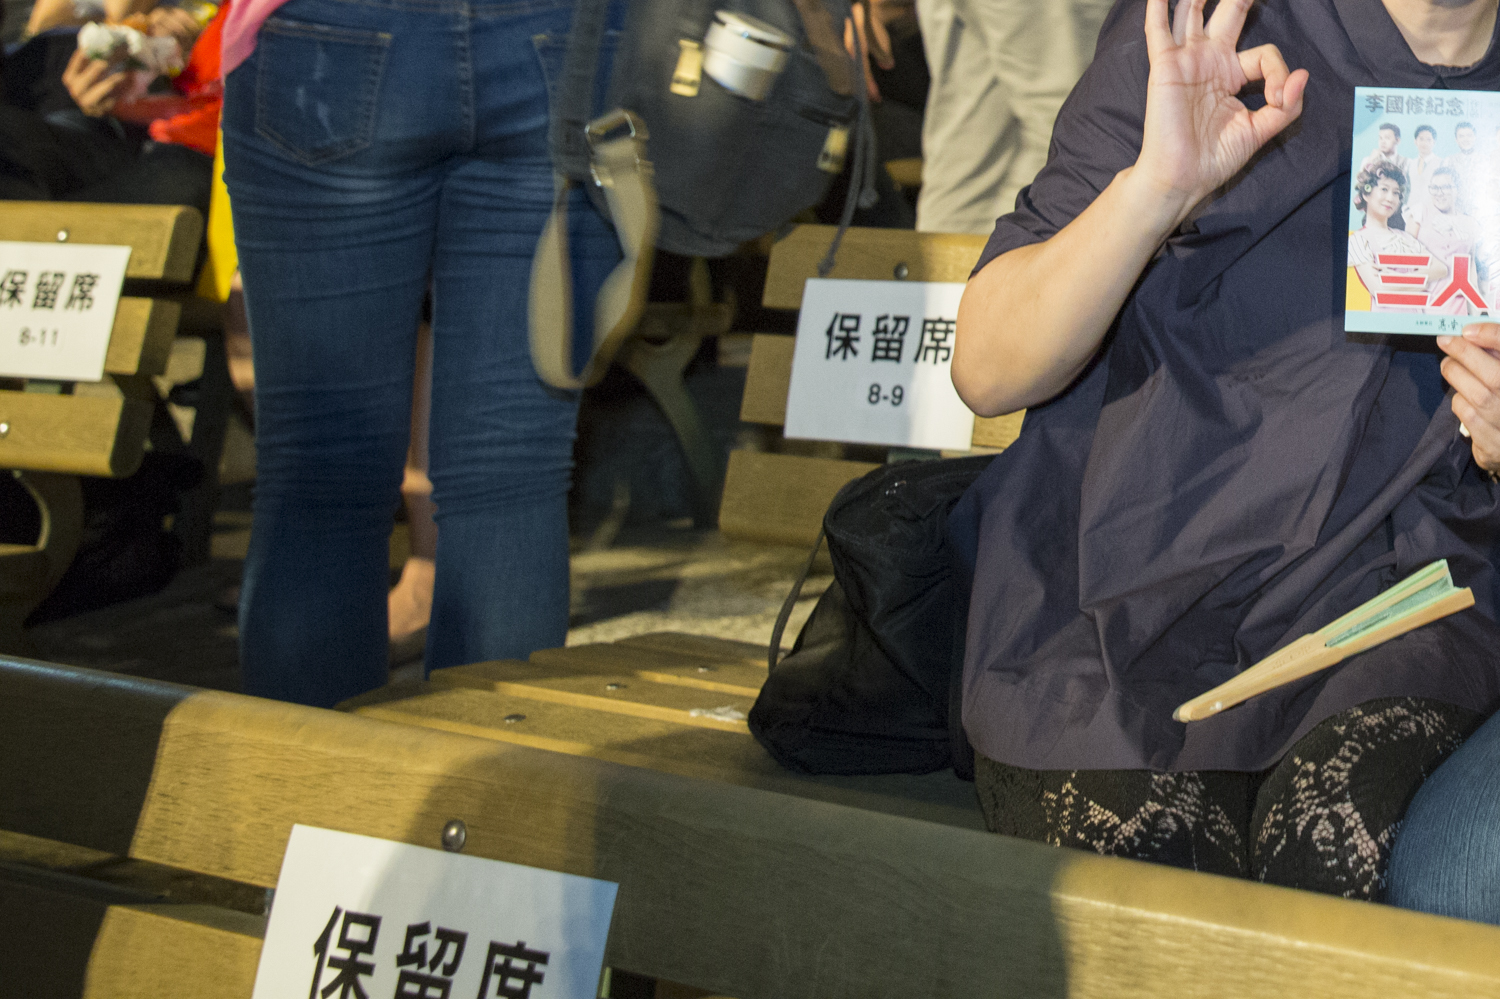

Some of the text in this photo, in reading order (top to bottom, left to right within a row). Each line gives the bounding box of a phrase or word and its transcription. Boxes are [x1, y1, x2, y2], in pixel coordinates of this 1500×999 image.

[1365, 93, 1465, 117] 李國修紀念
[0, 270, 100, 311] 保留席
[825, 311, 957, 366] 保留席
[867, 383, 904, 407] 8-9
